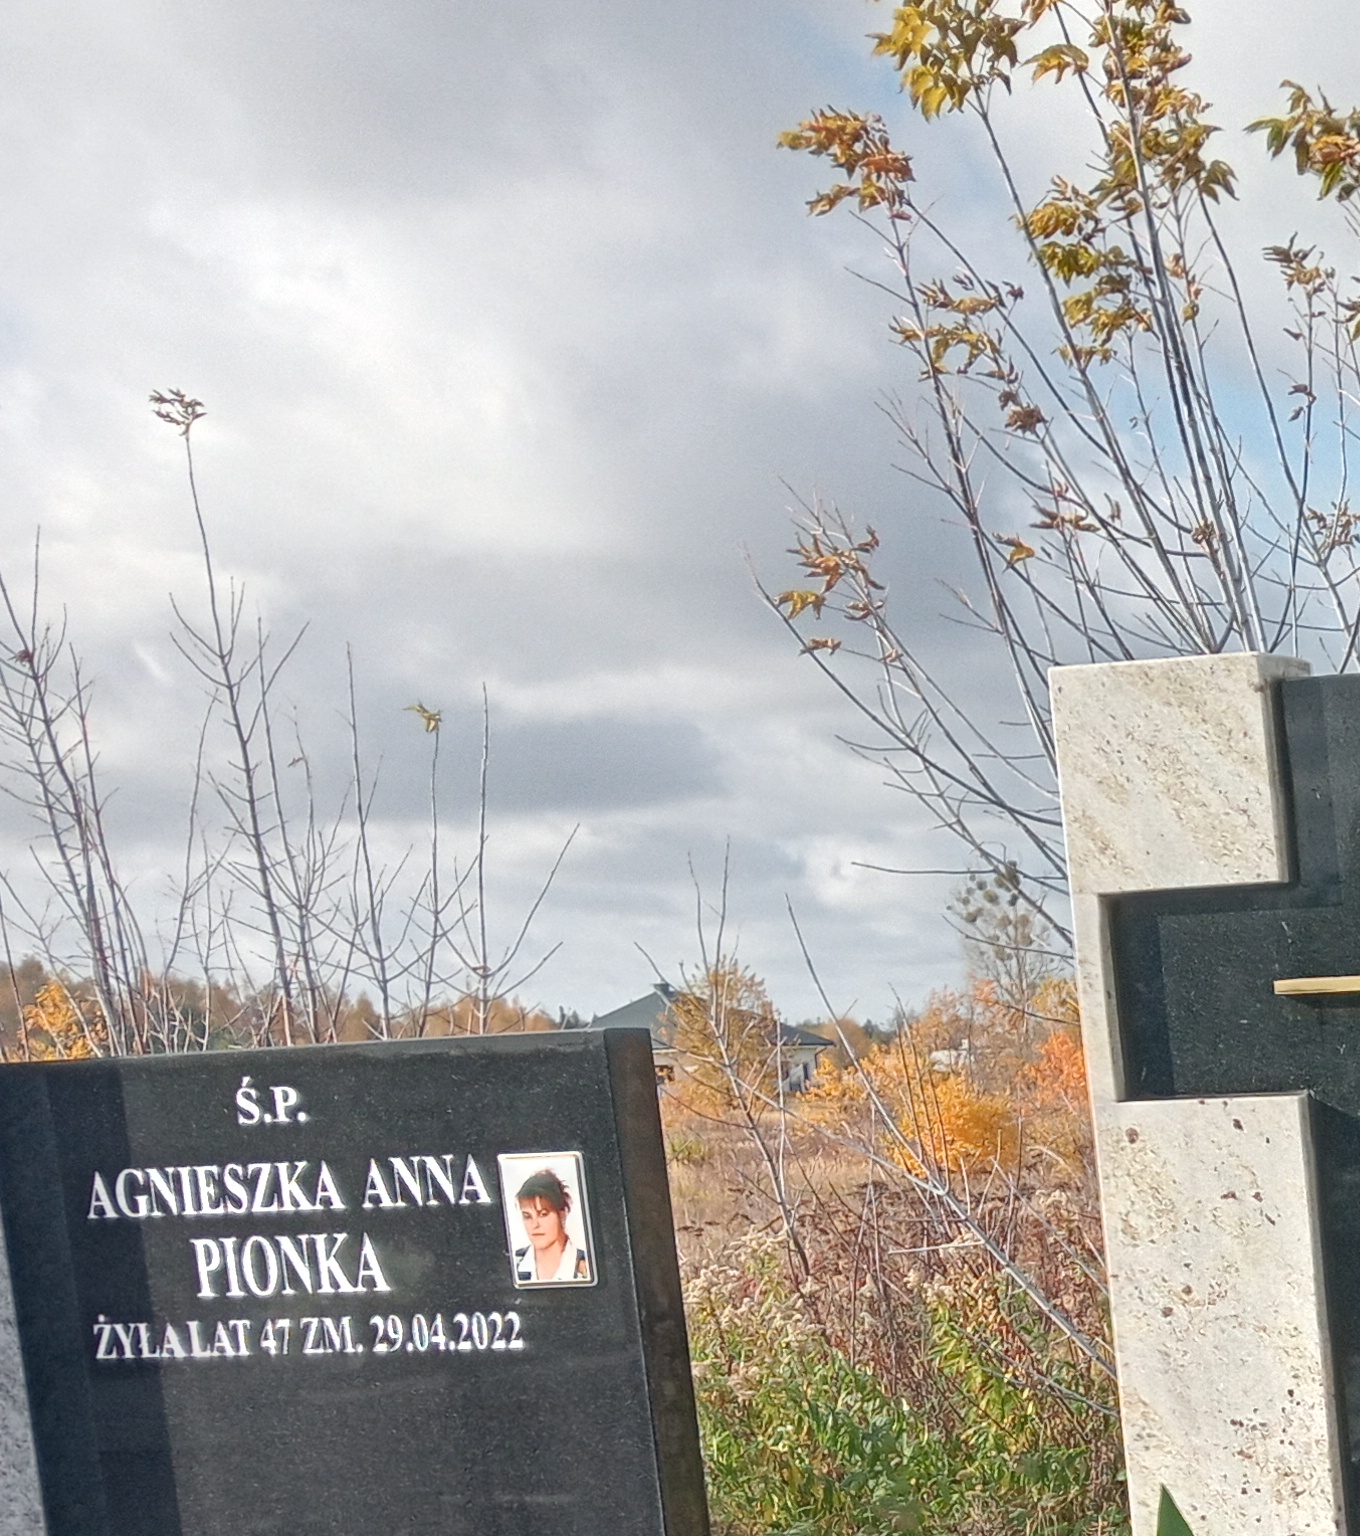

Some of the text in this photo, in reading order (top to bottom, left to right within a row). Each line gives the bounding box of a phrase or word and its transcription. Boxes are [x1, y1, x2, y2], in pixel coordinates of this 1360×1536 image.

[235, 1076, 309, 1126] Ś.P.
[86, 1153, 492, 1221] AGNIESZKA ANNA
[189, 1232, 391, 1299] PIONKA
[259, 1317, 291, 1356] 47
[300, 1315, 364, 1354] ZM.
[370, 1310, 525, 1353] 29.04.2022
